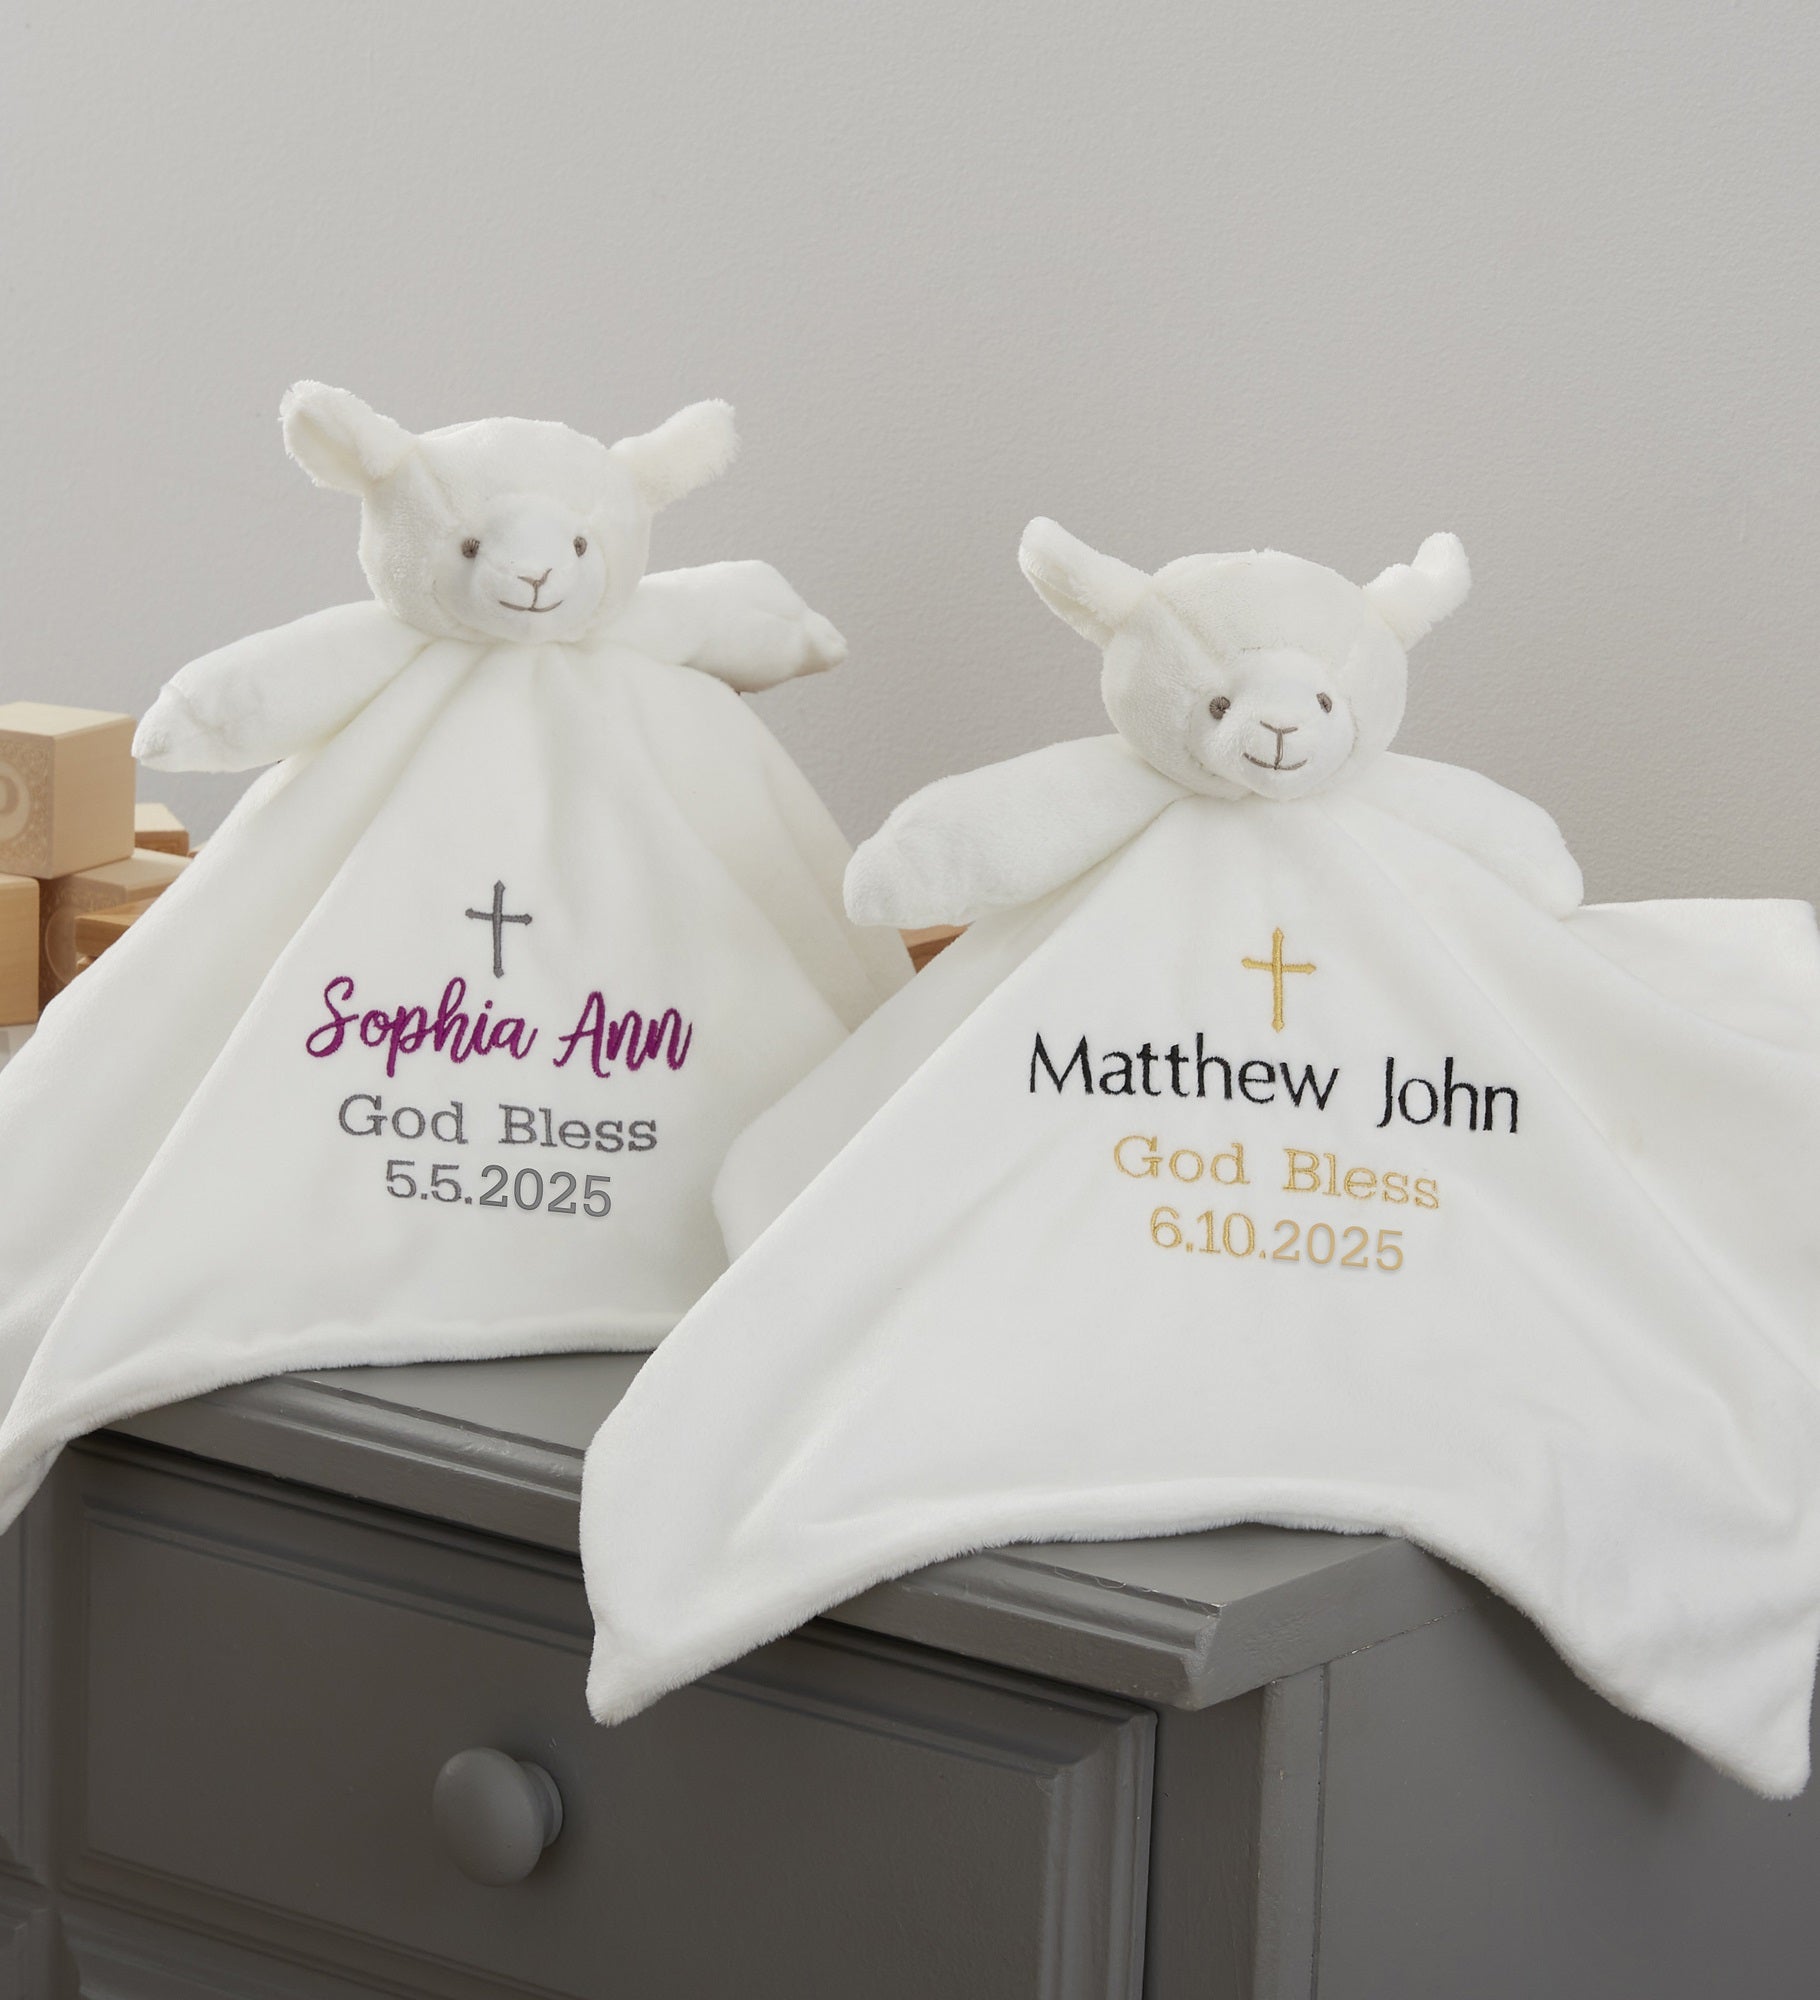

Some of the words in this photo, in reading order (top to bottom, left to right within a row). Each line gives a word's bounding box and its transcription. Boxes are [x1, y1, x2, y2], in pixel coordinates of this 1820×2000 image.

[306, 976, 538, 1078] Sophia
[553, 991, 692, 1078] Ann
[1029, 1032, 1340, 1111] Matthew
[1376, 1056, 1519, 1134] John
[338, 1093, 468, 1144] God
[498, 1103, 658, 1153] Bless
[385, 1160, 612, 1217] 5.5.2025
[1113, 1134, 1251, 1186] God
[1282, 1148, 1440, 1210] Bless
[1149, 1206, 1404, 1272] 6.10.2025
